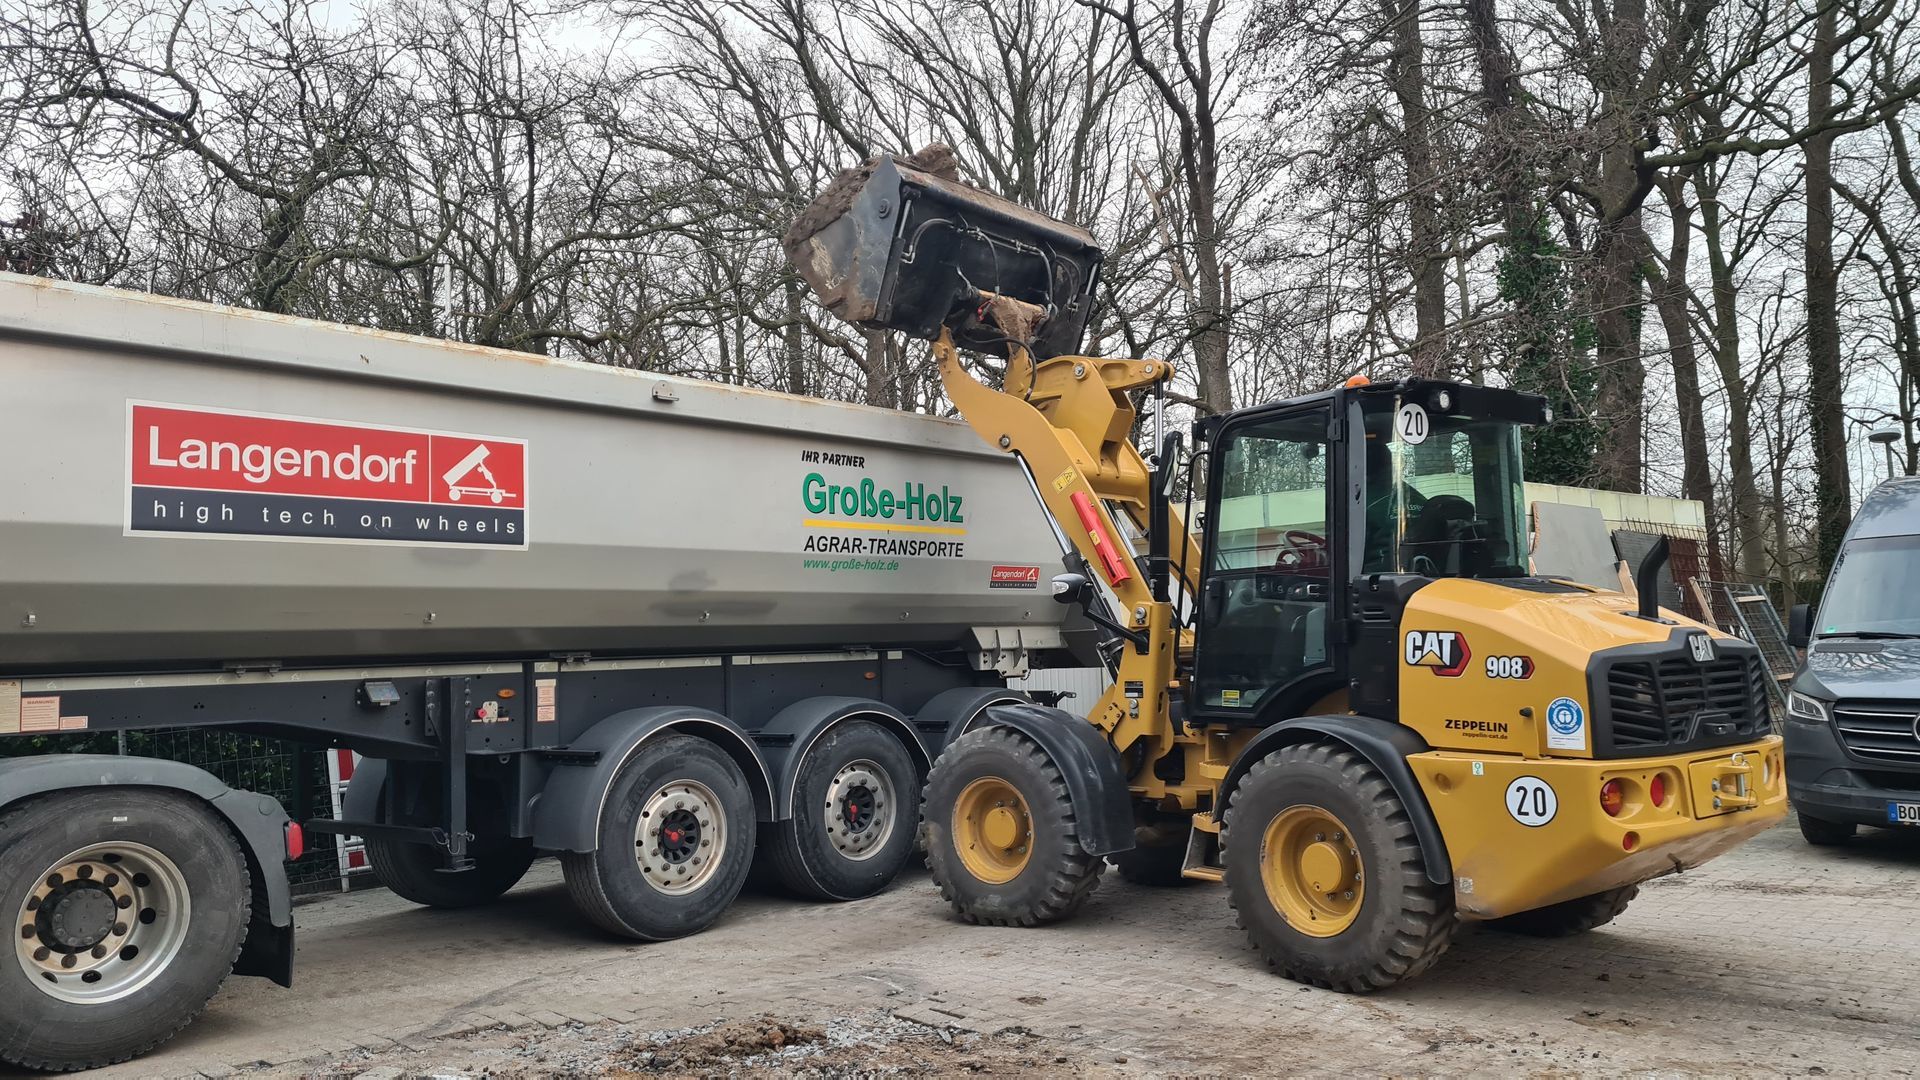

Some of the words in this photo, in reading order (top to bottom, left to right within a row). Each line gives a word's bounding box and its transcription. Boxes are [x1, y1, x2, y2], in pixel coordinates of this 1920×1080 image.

[1404, 411, 1423, 436] 20
[150, 426, 417, 484] Langendorf
[802, 450, 820, 464] IHR
[822, 452, 865, 468] PARTNER
[802, 472, 964, 523] Große-Holz
[154, 500, 233, 523] high
[262, 507, 334, 525] tech
[360, 515, 392, 528] on
[416, 515, 515, 534] wheels
[804, 535, 964, 557] AGRAR-TRANSPORTE
[803, 558, 899, 572] www.große-holz.de
[993, 569, 1025, 579] Langendorf
[1406, 631, 1456, 666] CAT
[1689, 635, 1714, 661] CAT
[1486, 656, 1523, 678] 908
[1445, 719, 1508, 732] ZEPPELIN
[1516, 785, 1547, 817] 20
